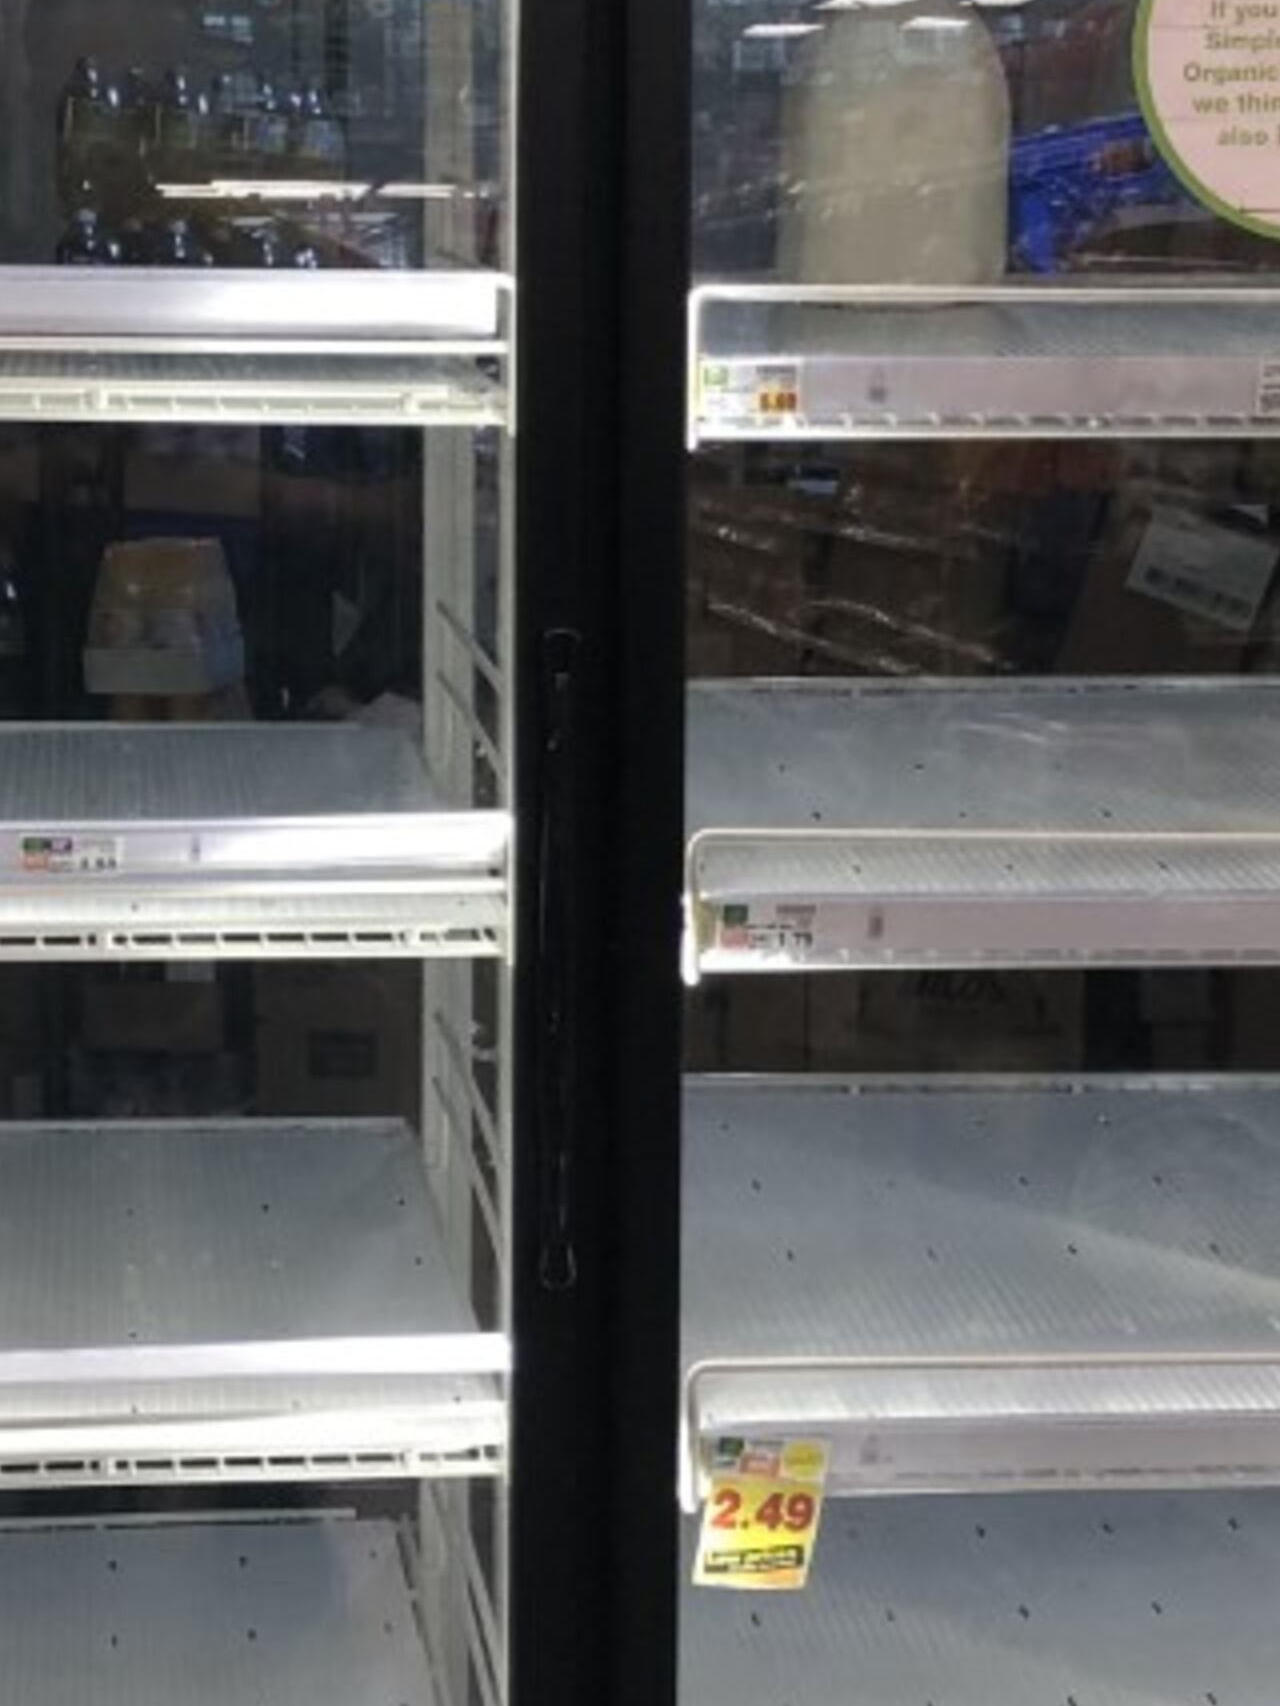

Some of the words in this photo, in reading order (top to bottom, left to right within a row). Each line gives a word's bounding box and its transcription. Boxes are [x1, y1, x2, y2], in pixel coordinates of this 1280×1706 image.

[1234, 2, 1278, 25] you
[1193, 98, 1228, 113] we
[1218, 125, 1268, 146] also
[710, 1487, 816, 1532] 2.49
